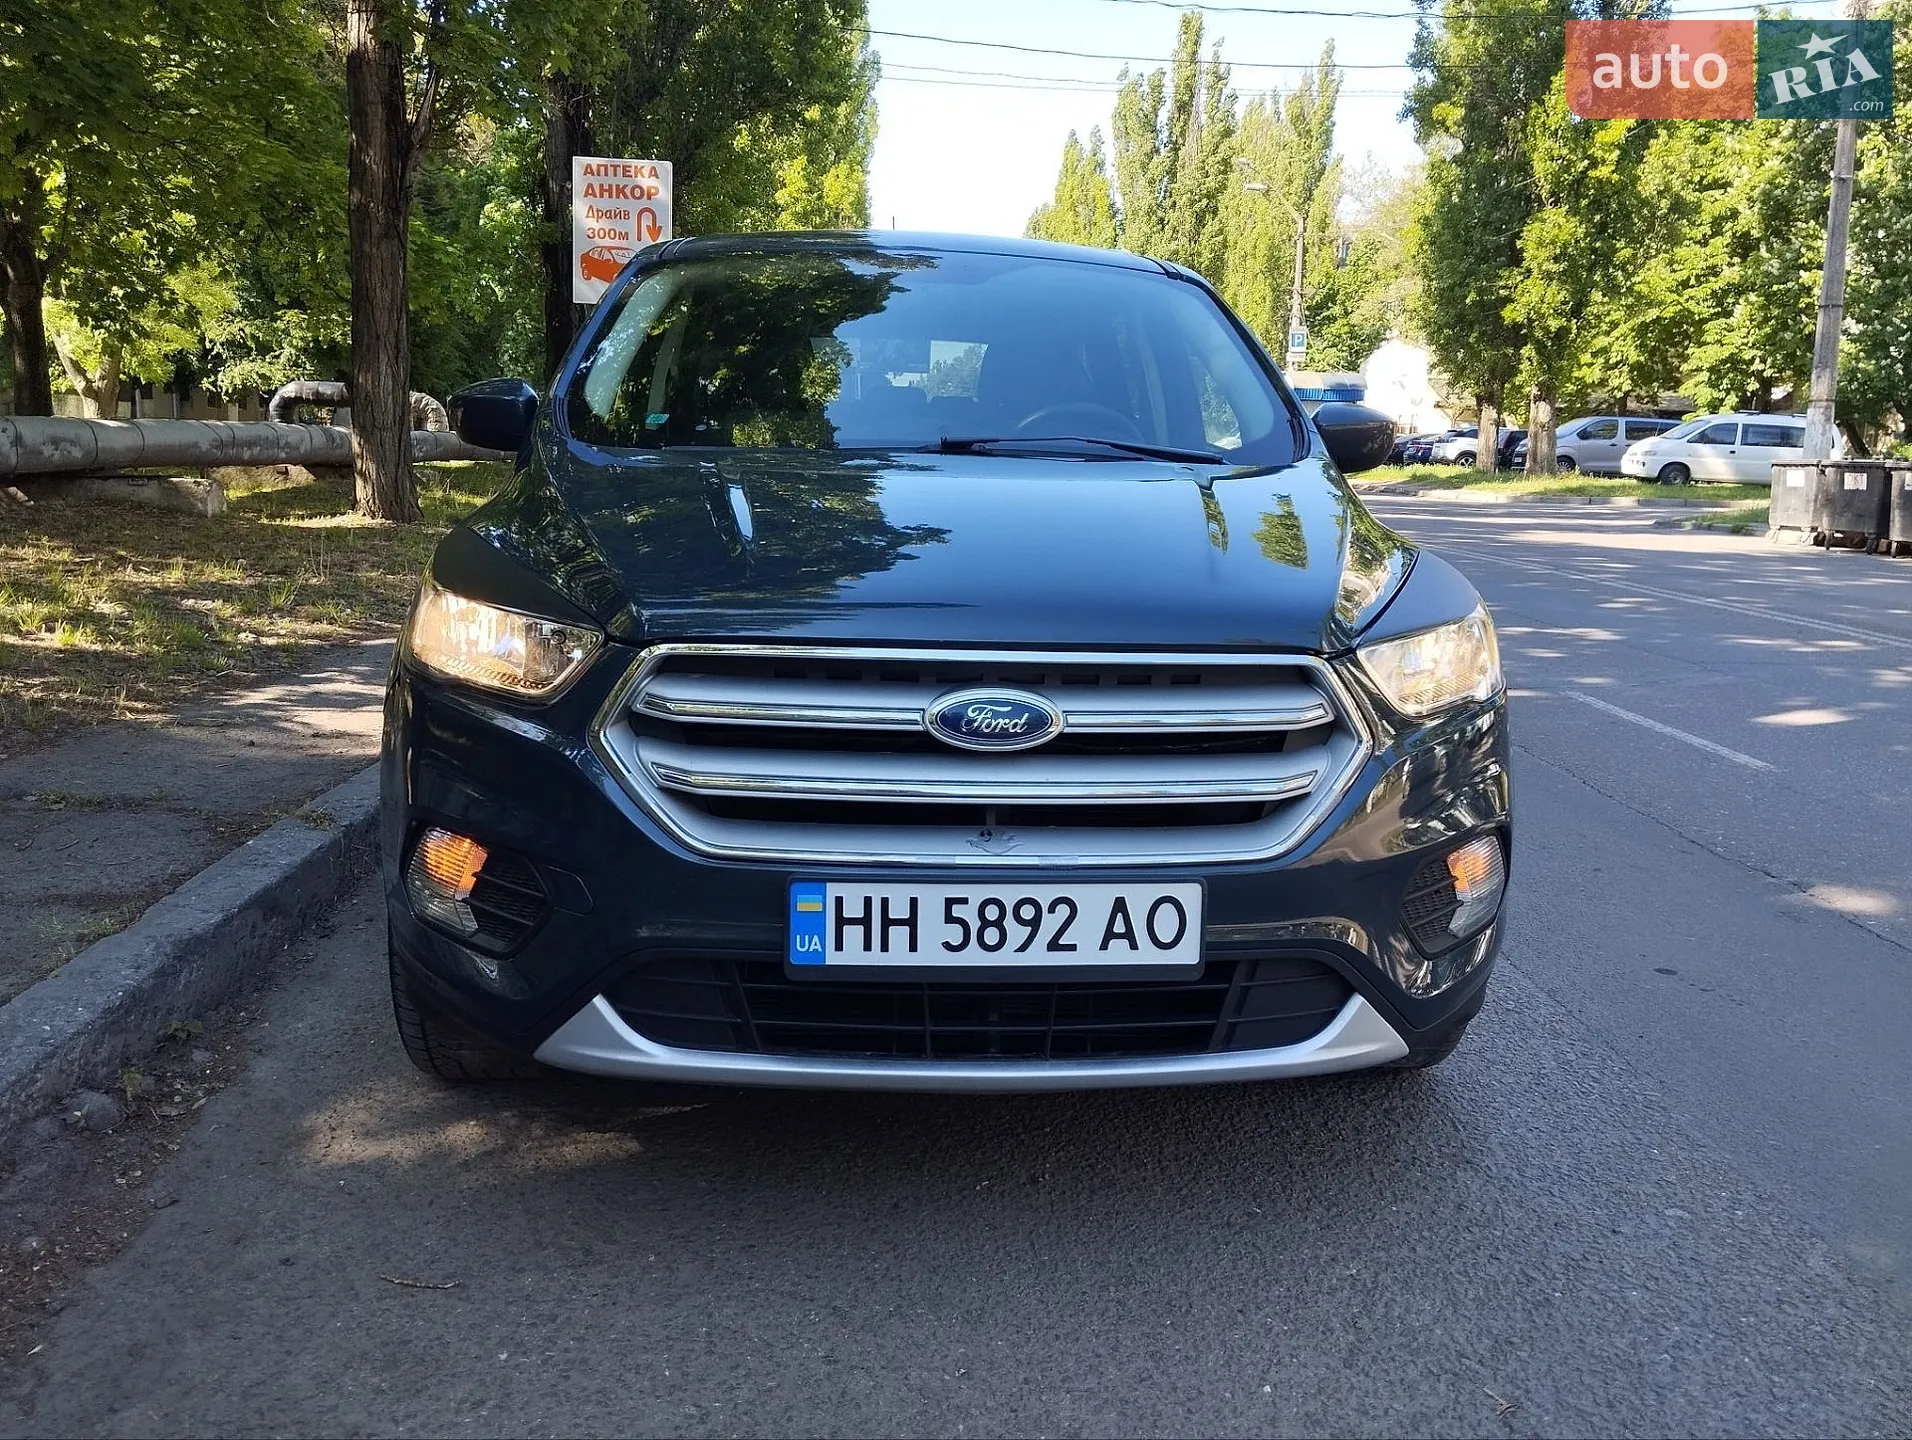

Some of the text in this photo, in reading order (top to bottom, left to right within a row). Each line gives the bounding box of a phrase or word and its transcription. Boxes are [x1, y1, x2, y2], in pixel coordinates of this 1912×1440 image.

[583, 163, 660, 179] АПТЕКА
[583, 183, 660, 200] АНКОР
[585, 205, 630, 222] Драйв
[587, 227, 629, 241] 300м
[1294, 334, 1303, 347] P
[961, 704, 1029, 733] Ford
[834, 894, 1188, 953] HH 5892 AO
[796, 934, 823, 954] UA
